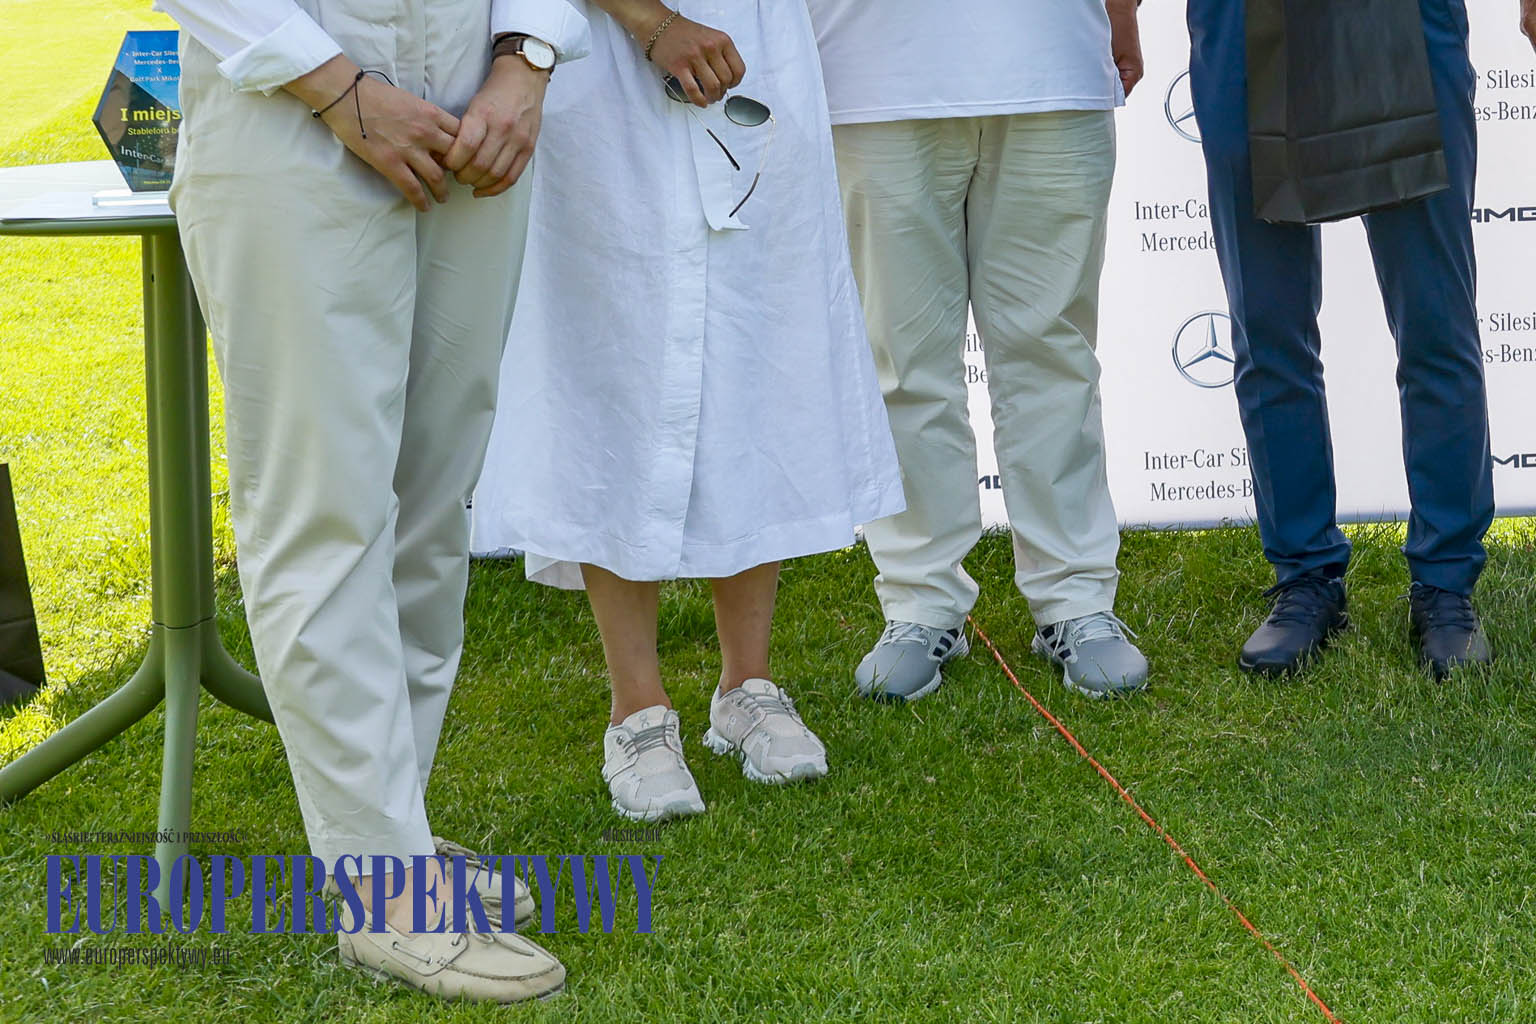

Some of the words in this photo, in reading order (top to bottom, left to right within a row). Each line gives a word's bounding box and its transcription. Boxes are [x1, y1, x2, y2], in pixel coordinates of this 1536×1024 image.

[120, 108, 128, 122] I
[133, 106, 181, 123] miejs
[127, 127, 170, 136] Stableford
[1134, 198, 1208, 221] Inter-Ca
[1141, 230, 1217, 252] Mercede
[1144, 448, 1225, 470] Inter-Car
[1150, 478, 1253, 502] Mercedes-B
